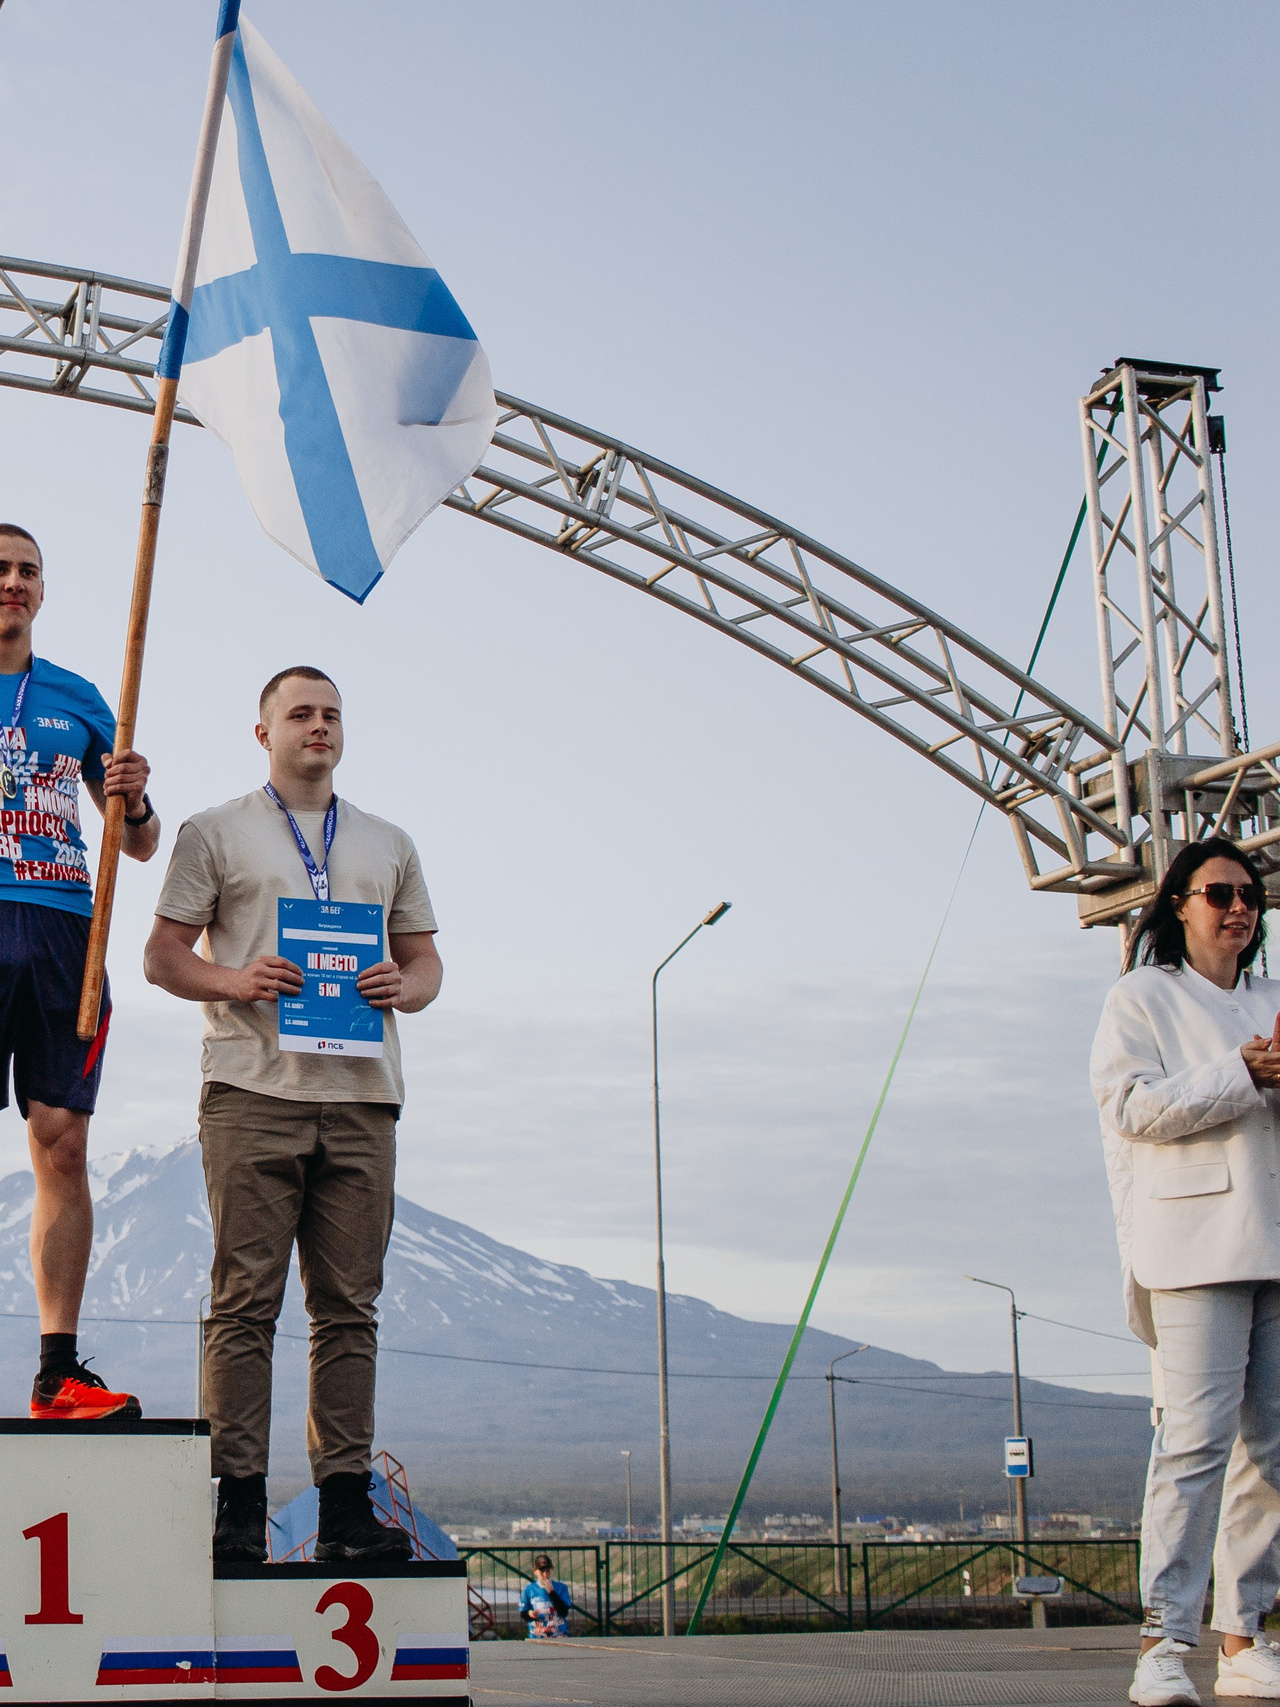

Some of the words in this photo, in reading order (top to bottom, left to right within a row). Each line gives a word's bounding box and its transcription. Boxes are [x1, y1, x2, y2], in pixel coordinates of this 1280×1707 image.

[319, 953, 358, 972] МЕСТО
[318, 983, 325, 996] 5
[326, 983, 341, 997] КМ
[328, 1042, 344, 1050] ПСБ
[22, 1512, 83, 1625] 1
[315, 1581, 380, 1691] 3
